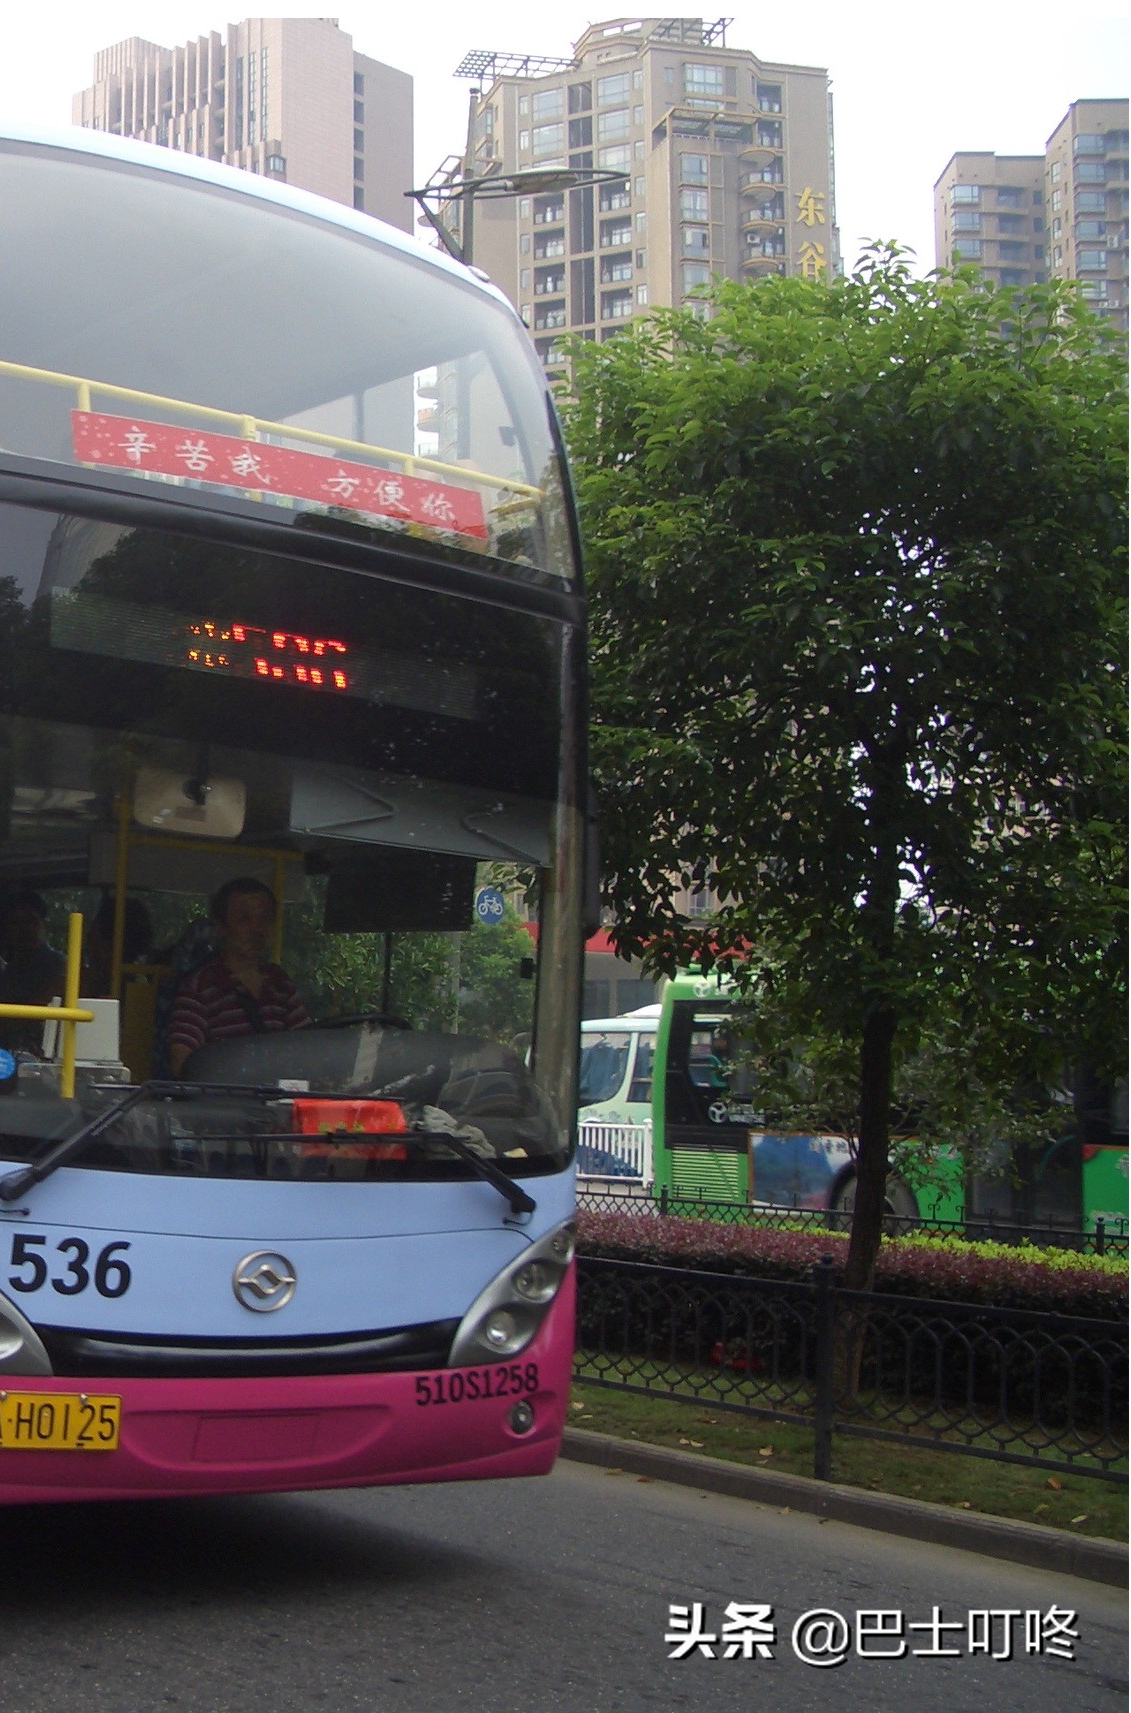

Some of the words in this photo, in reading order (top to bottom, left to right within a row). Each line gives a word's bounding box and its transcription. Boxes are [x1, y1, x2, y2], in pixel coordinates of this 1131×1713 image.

[117, 425, 271, 485] 辛苦我
[8, 1233, 132, 1299] 536
[414, 1362, 539, 1407] 510S1258
